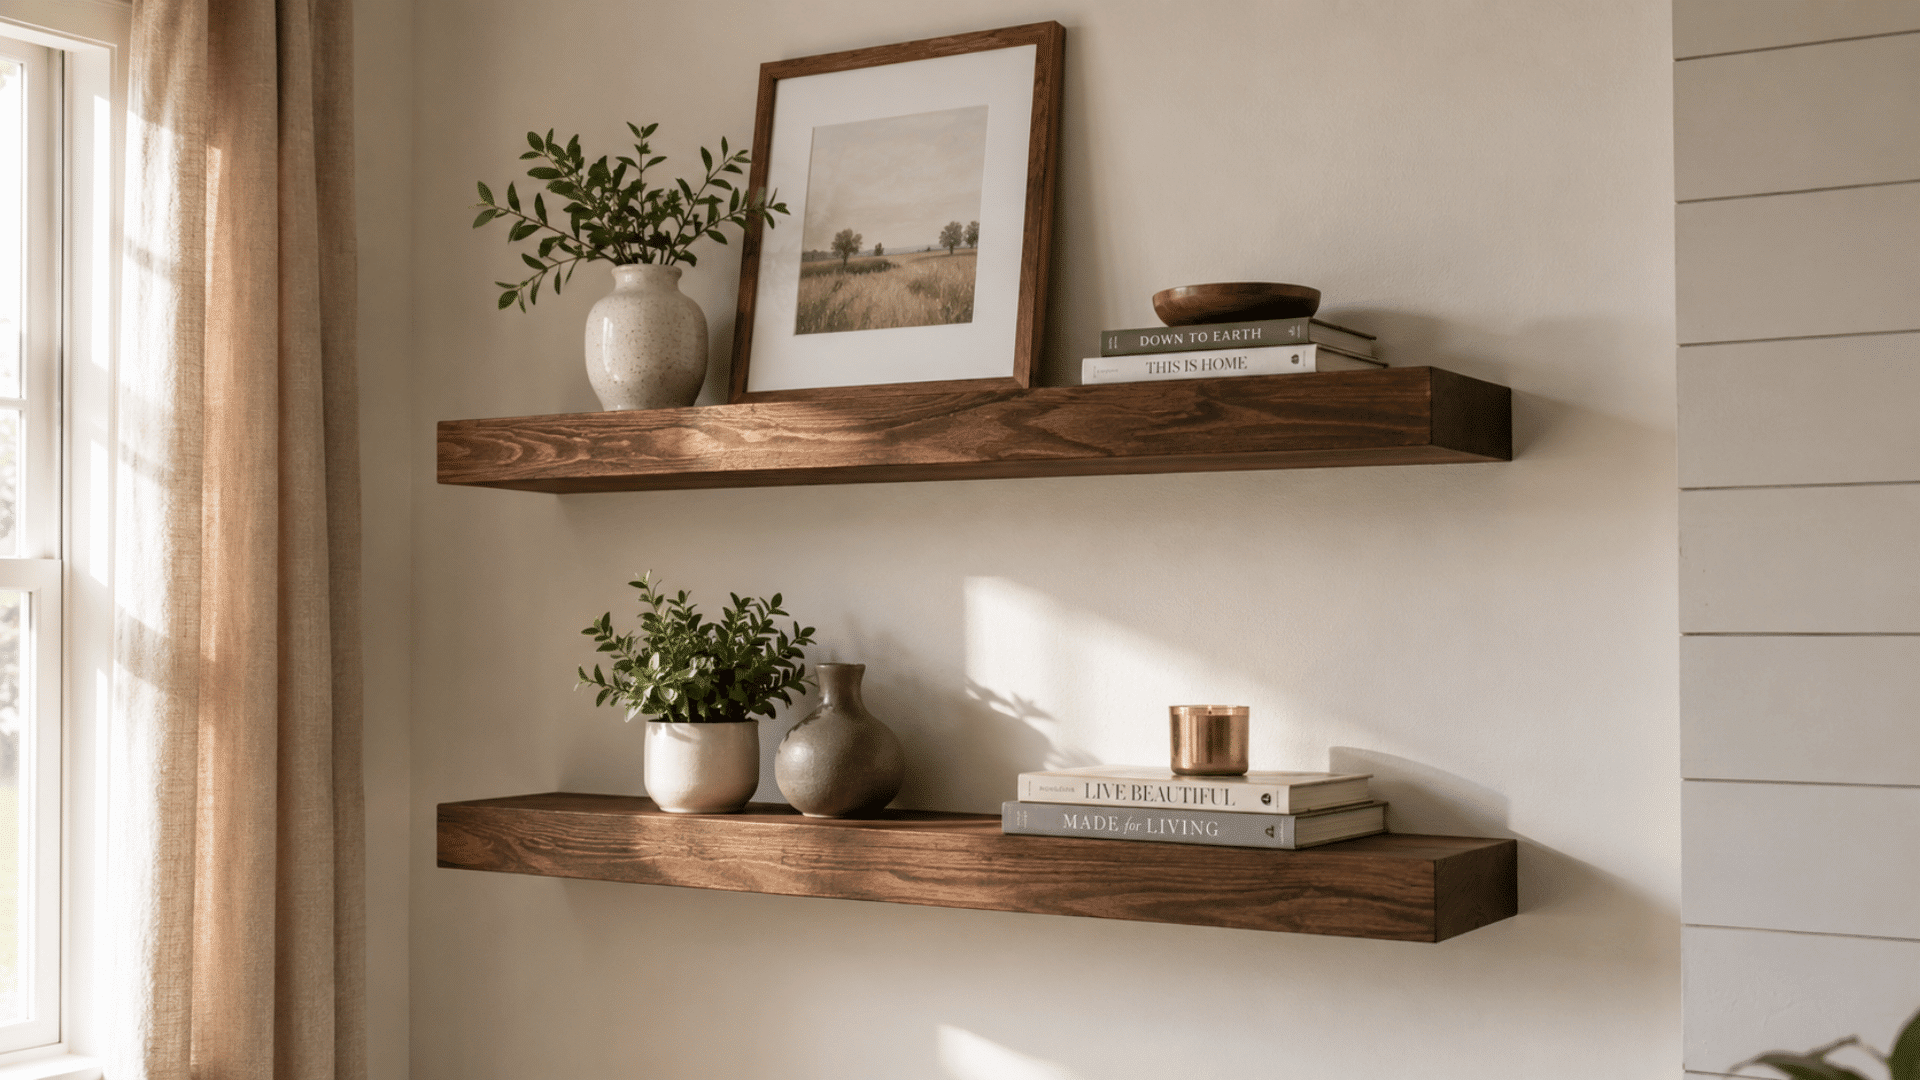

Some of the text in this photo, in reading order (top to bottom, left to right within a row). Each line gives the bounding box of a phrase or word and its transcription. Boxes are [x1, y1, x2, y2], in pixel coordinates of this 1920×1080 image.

[1140, 328, 1262, 347] DOWN TO EARTH
[1146, 356, 1248, 374] THIS IS HOME
[1085, 782, 1236, 807] LIVE BEAUTIFUL
[1062, 813, 1219, 837] MADE for LIVING
